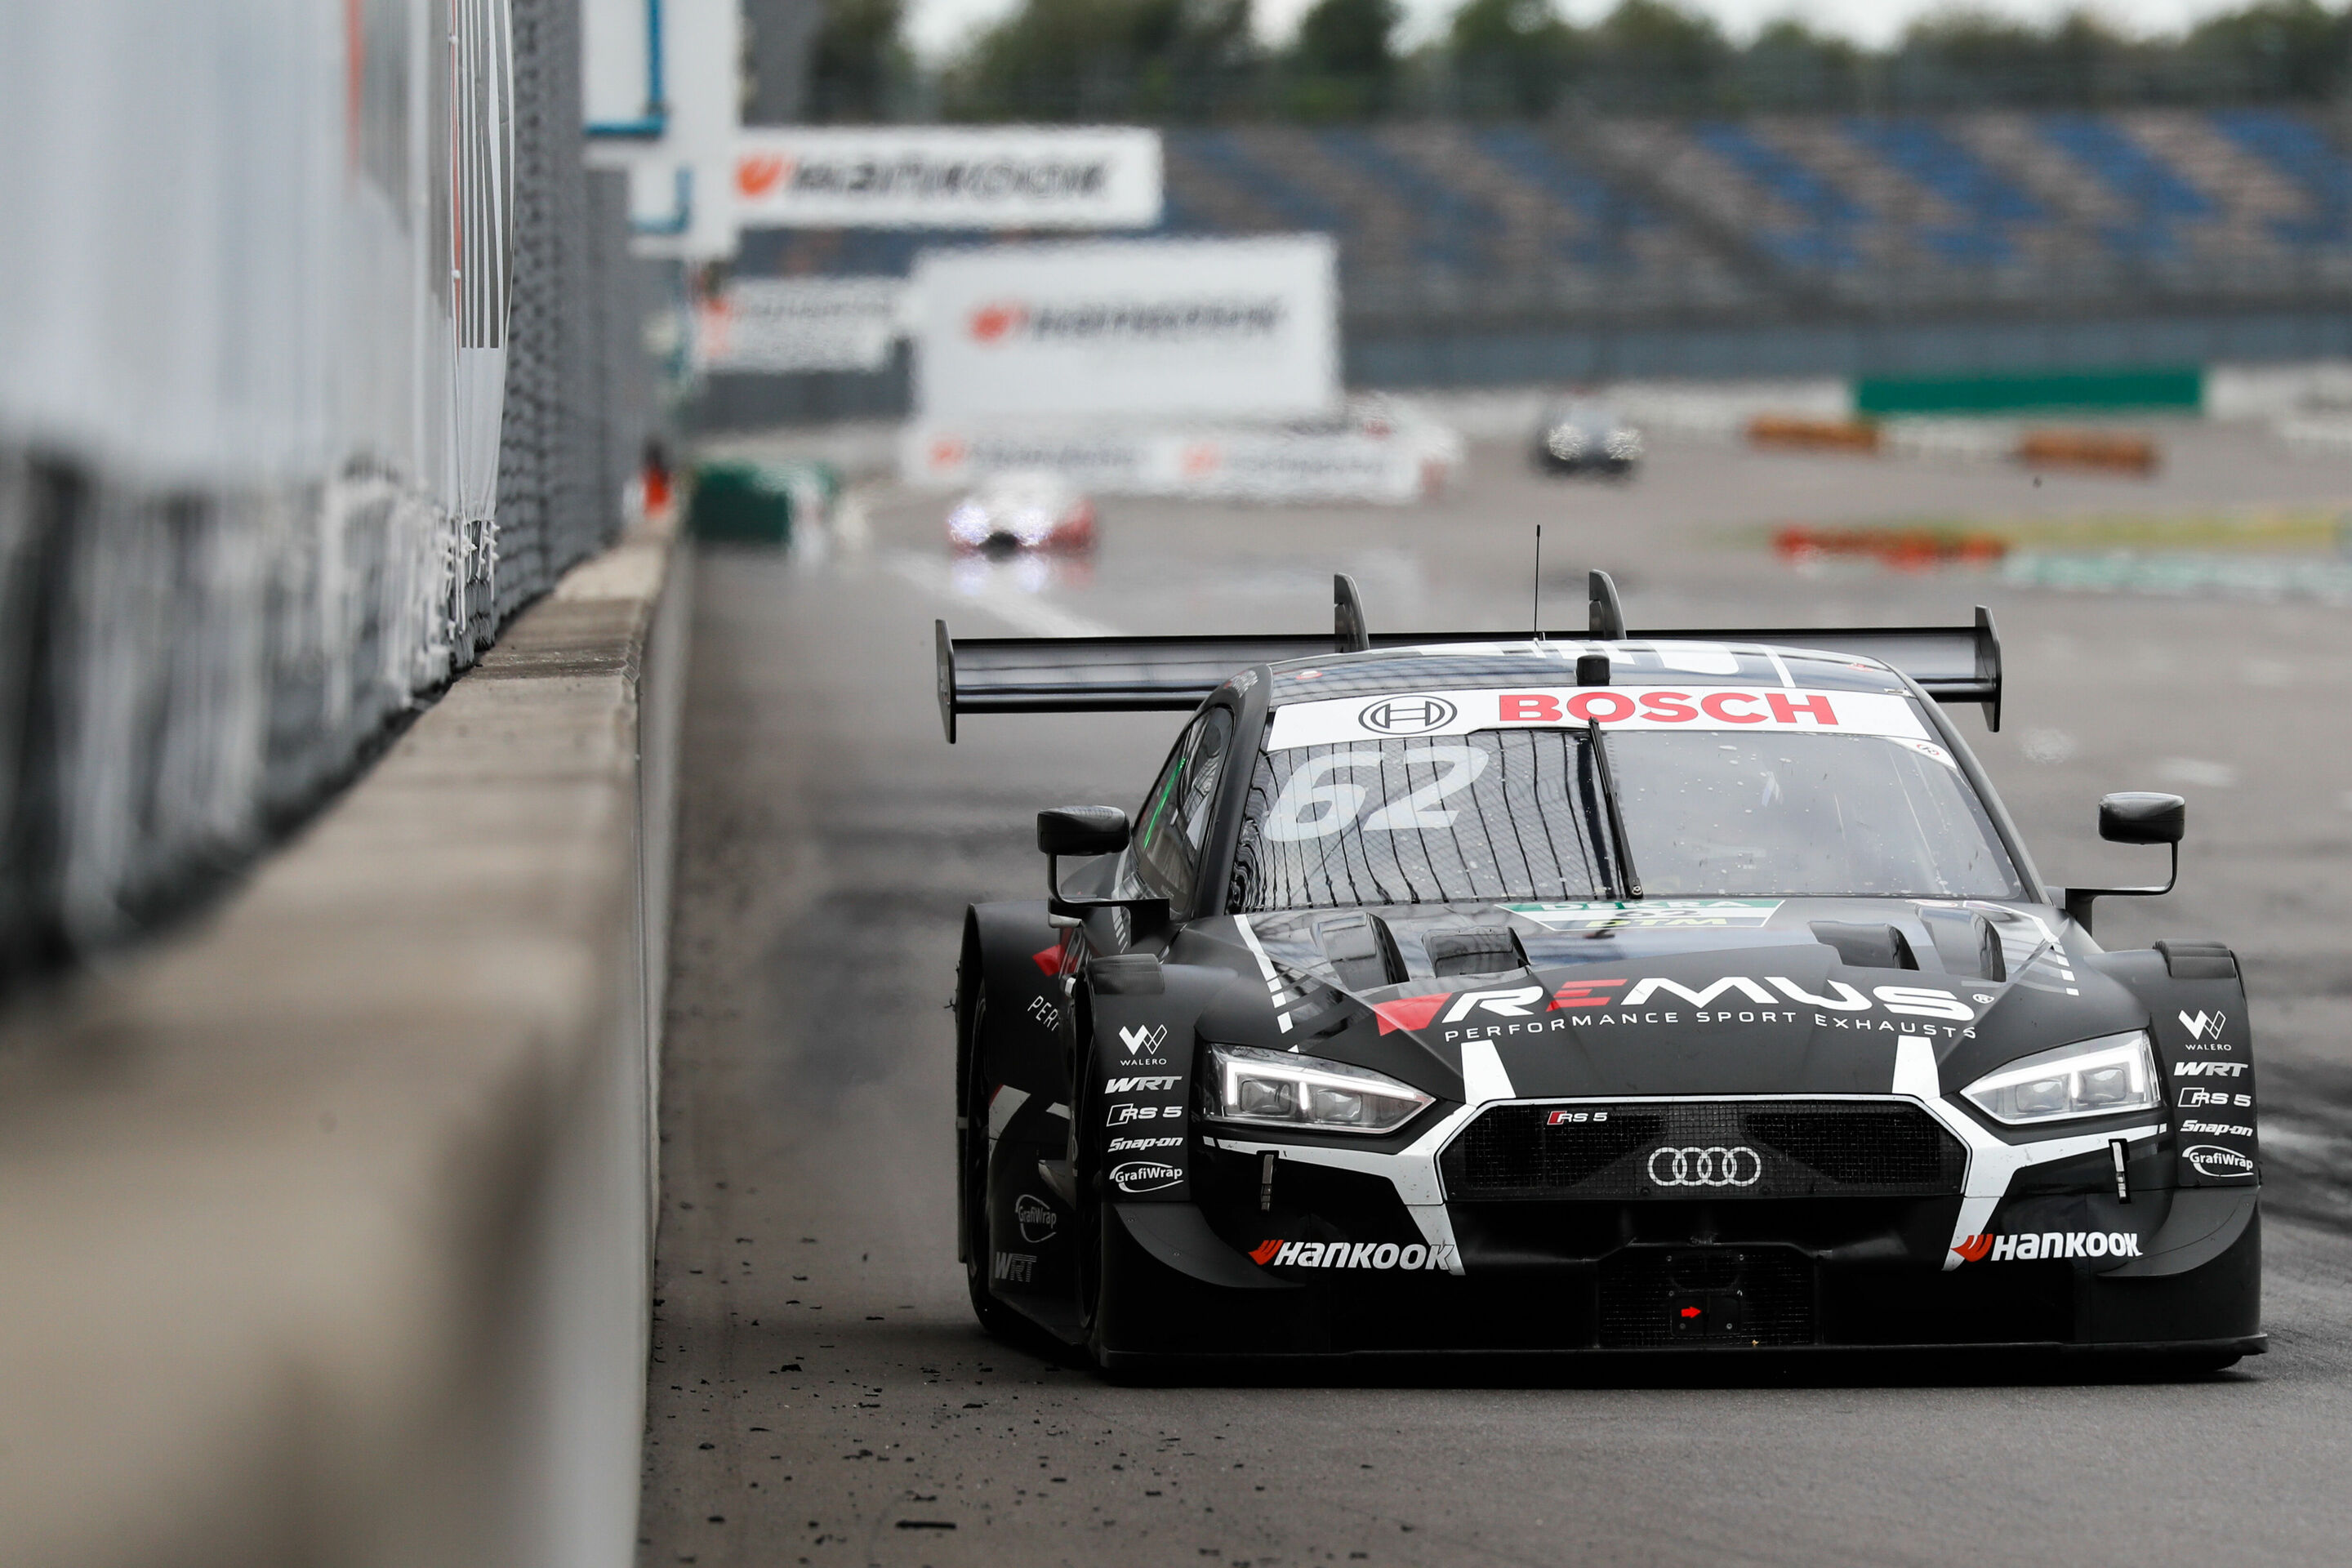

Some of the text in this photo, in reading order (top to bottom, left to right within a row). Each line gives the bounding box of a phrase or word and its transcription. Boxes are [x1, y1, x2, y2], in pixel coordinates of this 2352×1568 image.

[1499, 693, 1839, 725] BOSCH
[1263, 746, 1490, 843] 62
[1585, 917, 1728, 929] DTM
[1441, 977, 1976, 1024] REMUS
[1444, 1011, 1977, 1043] PERFORMANCE SPORT EXHAUSTS
[2184, 1044, 2233, 1052] WALERO
[1119, 1058, 1168, 1067] WALERO
[2173, 1062, 2248, 1078] WRT
[1104, 1076, 1183, 1094] WRT
[2233, 1094, 2252, 1108] 5
[1162, 1106, 1183, 1119] 5
[1592, 1111, 1608, 1122] 5
[2180, 1119, 2253, 1137] Snap-on
[1107, 1137, 1184, 1153] Snap-on
[2189, 1152, 2254, 1171] GrafiWrap
[1115, 1166, 1183, 1183] GrafiWrap
